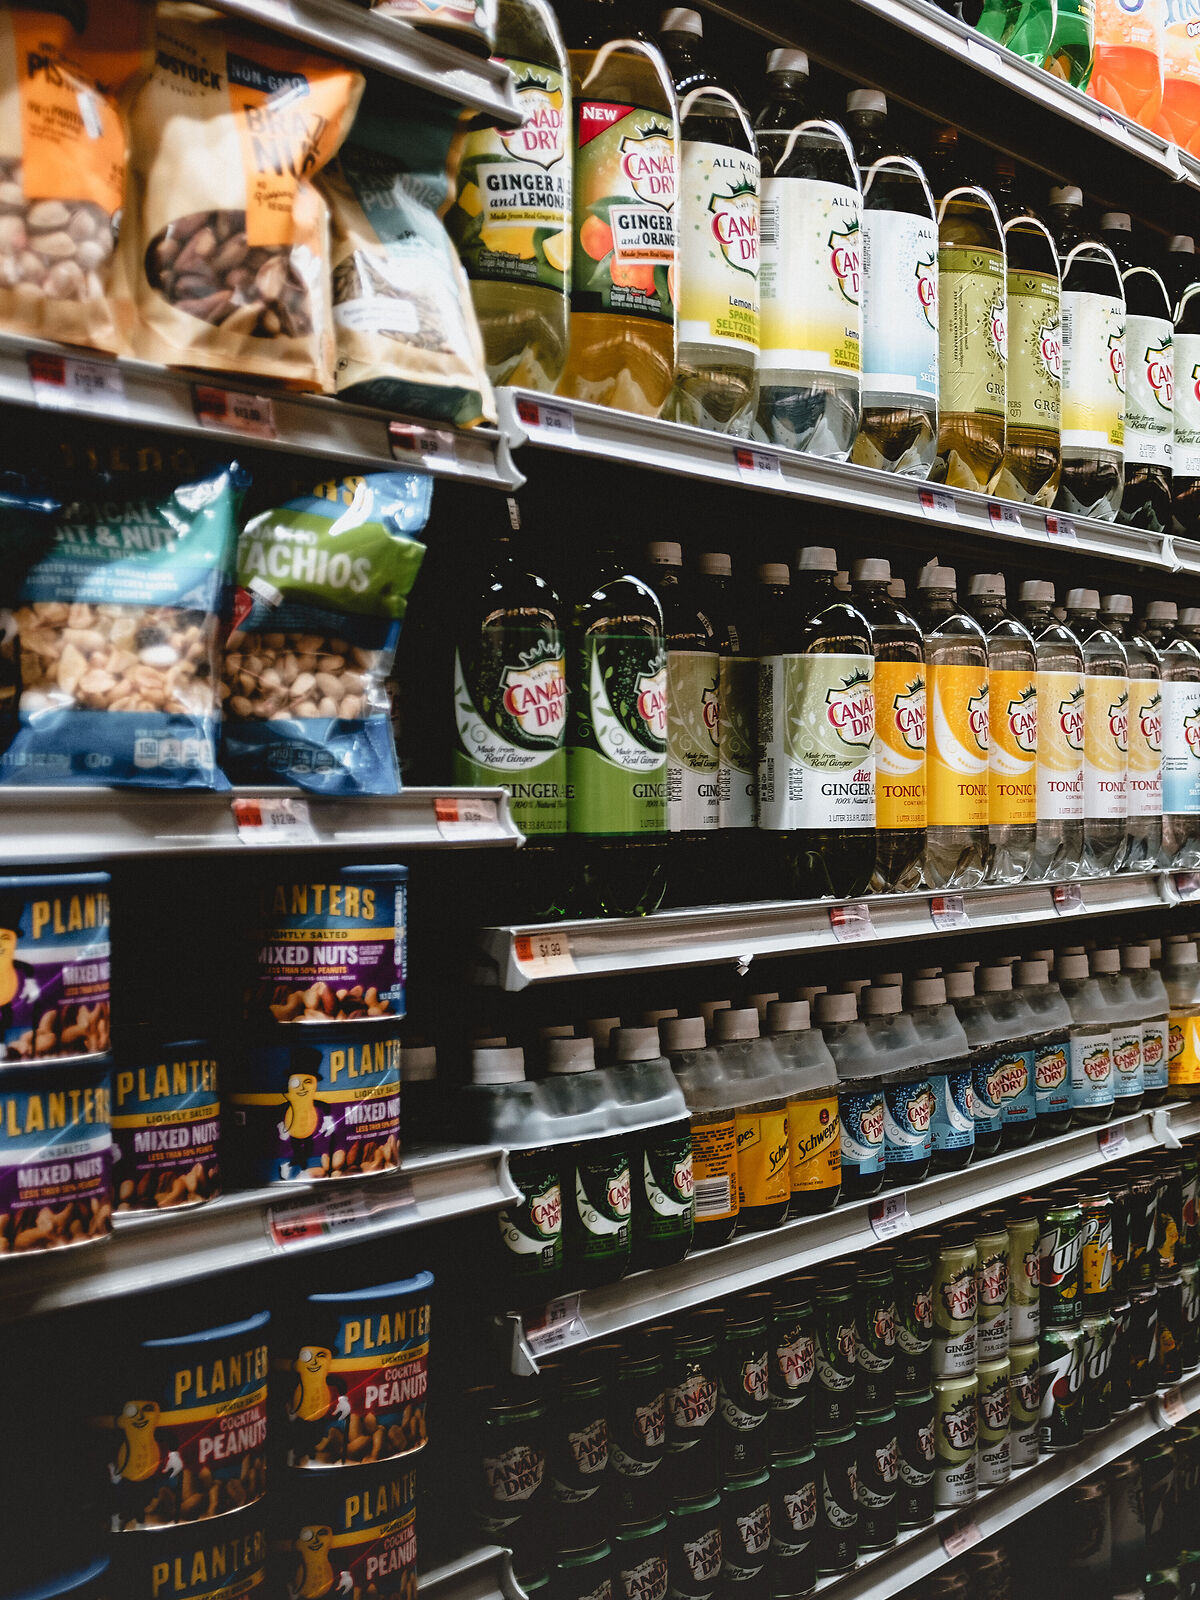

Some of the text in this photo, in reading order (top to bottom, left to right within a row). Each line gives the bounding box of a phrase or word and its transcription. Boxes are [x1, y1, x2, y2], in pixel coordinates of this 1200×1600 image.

[583, 107, 618, 121] NEW
[523, 130, 559, 151] DRY
[621, 153, 674, 180] CANAD
[713, 158, 735, 168] ALL
[486, 174, 553, 191] GINGER
[490, 194, 517, 208] and
[832, 198, 848, 207] ALL
[619, 215, 673, 231] GINGER
[621, 235, 640, 245] and
[831, 248, 859, 278] CAN
[729, 296, 751, 309] Lemon
[1042, 339, 1061, 361] CAN
[1147, 362, 1173, 390] CAN
[1130, 420, 1168, 433] Real Ginger
[1177, 435, 1194, 444] Real
[96, 526, 119, 546] &
[237, 537, 371, 593] TACHIOS
[503, 677, 565, 717] CANAD
[637, 690, 666, 721] CAN
[535, 700, 563, 727] DRY
[827, 696, 874, 728] CANAD
[969, 710, 989, 733] CAN
[852, 717, 874, 737] DRY
[1060, 712, 1084, 735] CAN
[1109, 715, 1127, 737] CAN
[1141, 716, 1161, 737] CAN
[484, 753, 536, 765] Real Ginger
[622, 755, 660, 766] Real Ginger
[811, 758, 852, 770] Real Ginger
[853, 769, 872, 782] diet
[821, 783, 870, 796] GINGER
[883, 785, 921, 798] TONIC
[996, 784, 1034, 796] TONIC
[1048, 781, 1079, 793] TONIC
[1130, 780, 1159, 791] TONIC
[258, 946, 358, 965] MIXED NUTS
[1113, 1046, 1140, 1066] CANADA
[1124, 1056, 1137, 1068] DRY
[1147, 1052, 1159, 1062] DRY
[1037, 1058, 1067, 1080] ANADA
[1044, 1071, 1062, 1085] DRY
[1095, 1066, 1108, 1078] DRY
[117, 1060, 217, 1106] PLANTER
[344, 1101, 385, 1126] MIXED
[134, 1129, 190, 1153] MIXED
[17, 1164, 71, 1189] MIXED
[674, 1169, 693, 1189] CAN
[344, 1304, 430, 1354] PLANTER
[978, 1326, 1005, 1338] GINGER
[945, 1342, 974, 1354] GINGER
[365, 1371, 428, 1409] PEANUTS
[683, 1398, 714, 1423] DRY
[199, 1416, 267, 1464] PEANUTS
[946, 1472, 975, 1483] GINGER
